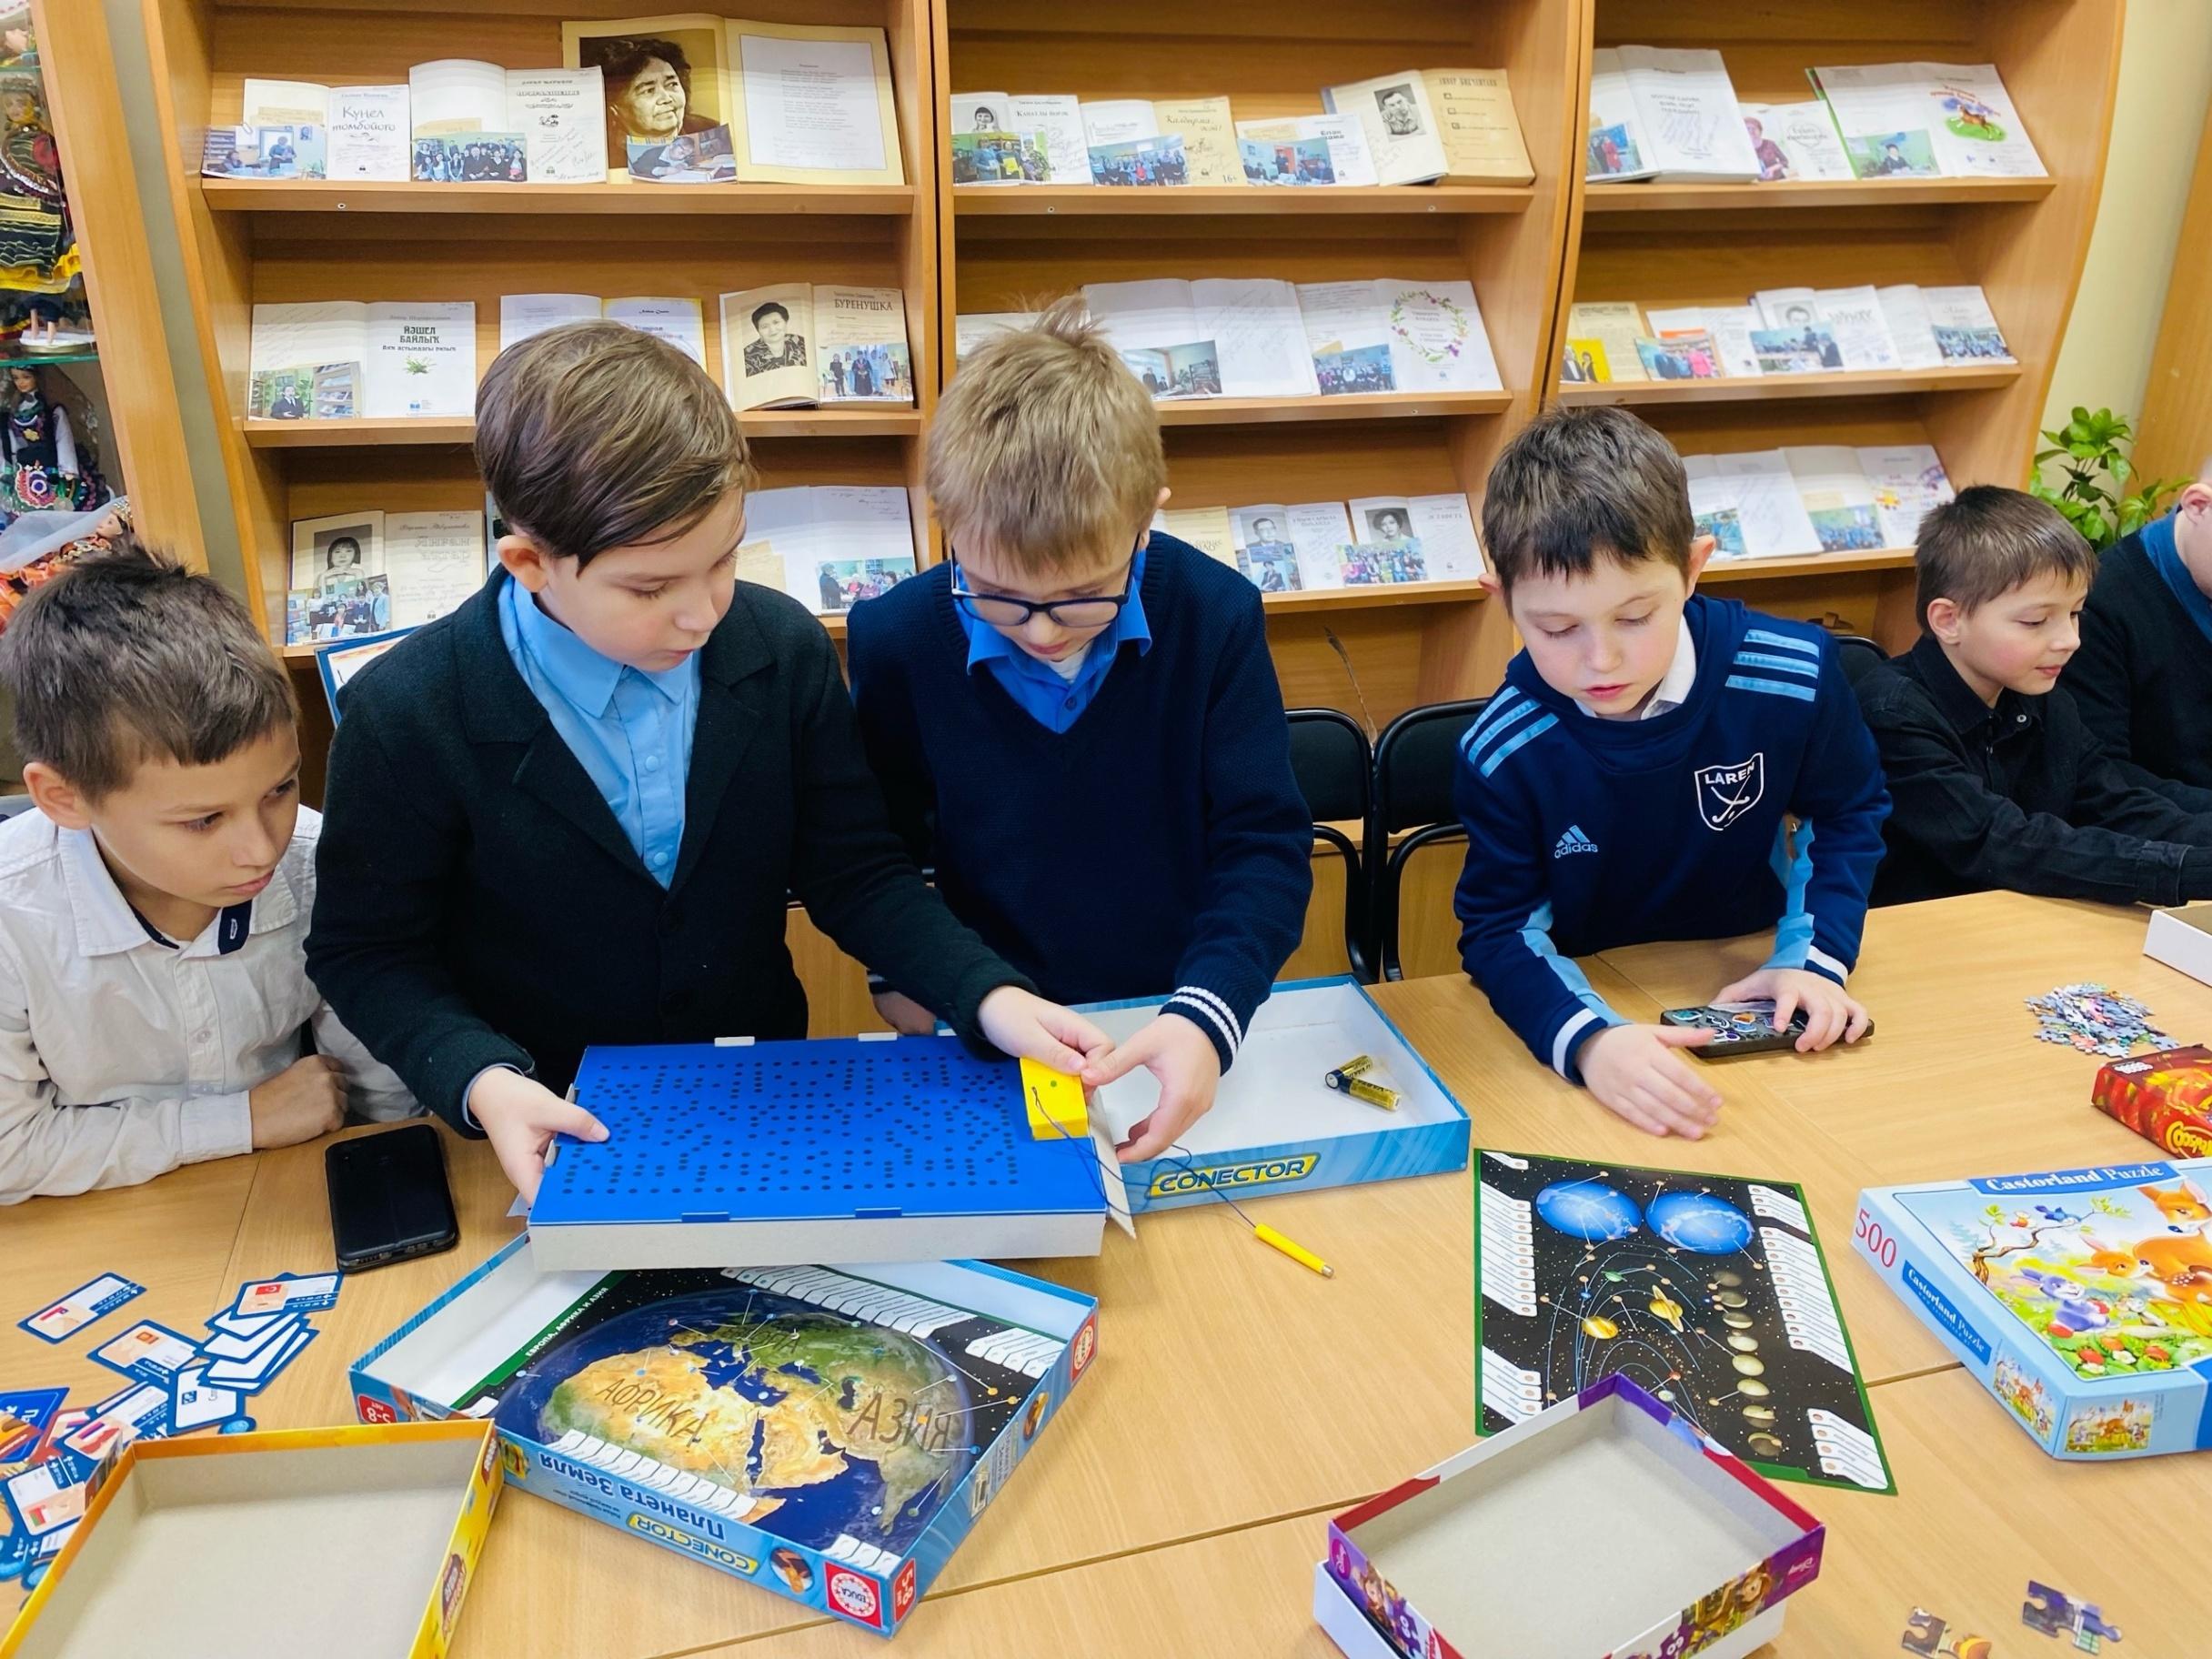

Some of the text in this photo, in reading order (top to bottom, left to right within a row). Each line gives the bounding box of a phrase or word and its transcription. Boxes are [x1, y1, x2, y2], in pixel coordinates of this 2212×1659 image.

[834, 298, 893, 311] БУРЕНУШКА
[1704, 761, 1756, 786] LAREN
[1553, 842, 1599, 860] adidas
[1159, 1159, 1306, 1192] CONECTOR
[1986, 1164, 2165, 1192] Castorland Puzzle
[1855, 1207, 1897, 1269] 500
[556, 1308, 585, 1332] АФРИКА
[589, 1287, 608, 1302] АЗИЯ
[1908, 1269, 1985, 1353] Castorland Puzzle
[595, 1378, 709, 1447] АФРИКА
[846, 1392, 952, 1451] АЗИЯ
[538, 1453, 614, 1495] Земля
[620, 1484, 725, 1541] Планета
[637, 1516, 750, 1572] CONECTOR
[840, 1587, 867, 1604] EDUCA
